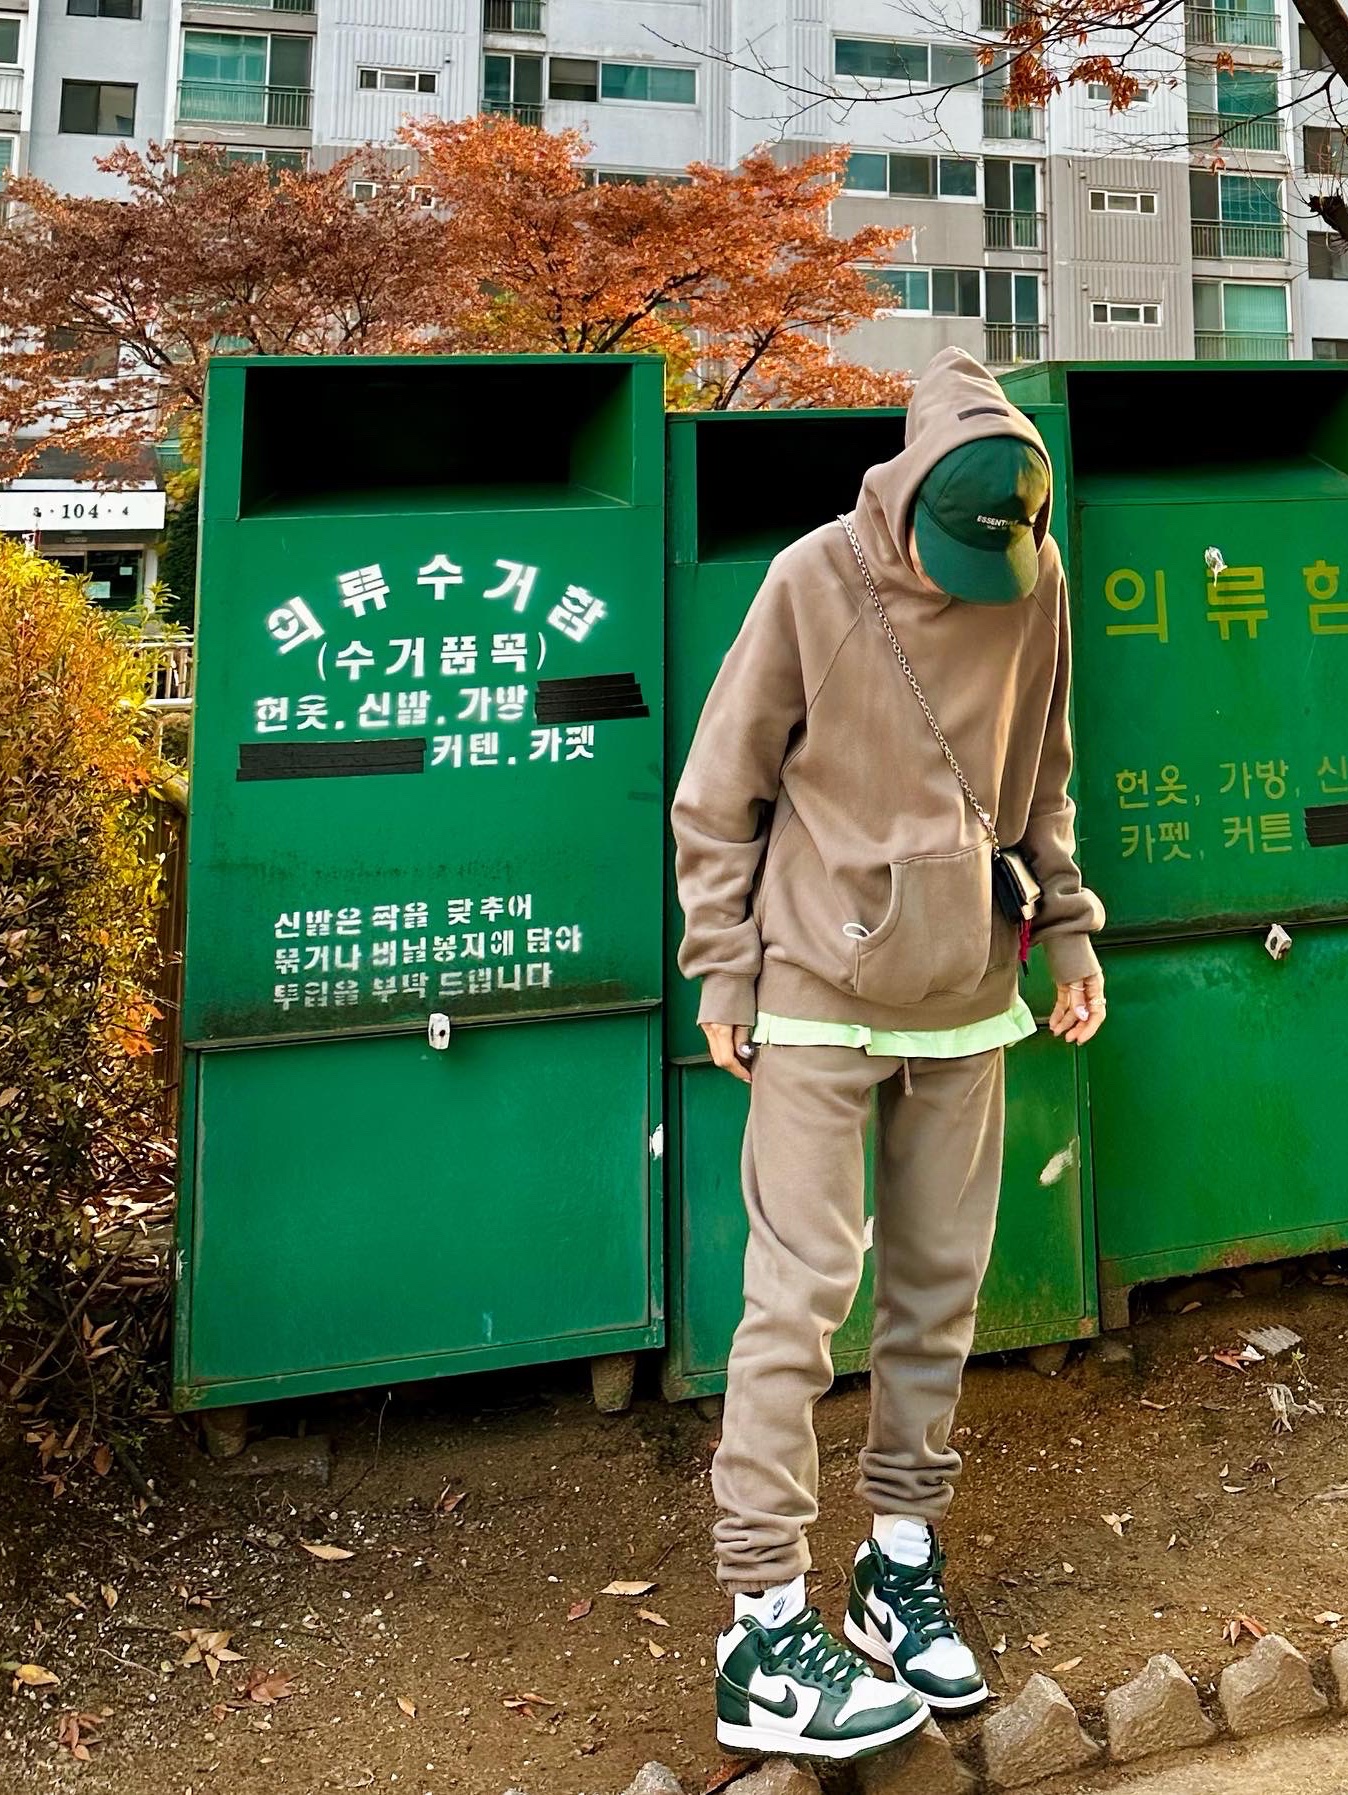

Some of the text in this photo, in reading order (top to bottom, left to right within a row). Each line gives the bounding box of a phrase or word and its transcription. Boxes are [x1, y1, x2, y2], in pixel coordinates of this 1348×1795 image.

[62, 503, 98, 519] 104
[122, 506, 129, 516] 4
[529, 725, 595, 762] 카펫
[274, 893, 532, 939] 신발은 짝을 맞추어
[274, 924, 583, 975] 묶거나 비닐봉지에 담아
[273, 962, 554, 1012] 투입을 부탁 드립니다
